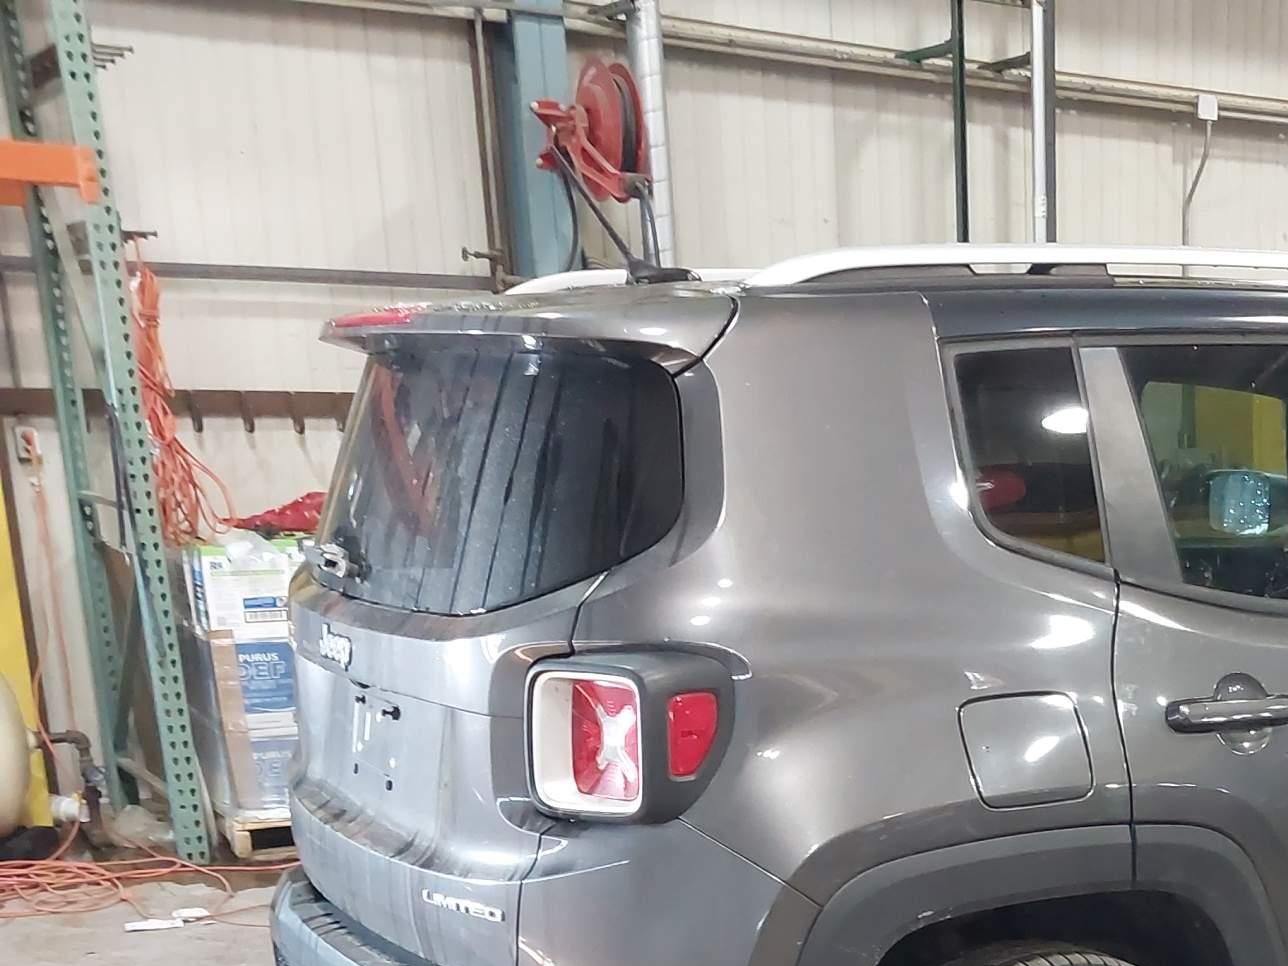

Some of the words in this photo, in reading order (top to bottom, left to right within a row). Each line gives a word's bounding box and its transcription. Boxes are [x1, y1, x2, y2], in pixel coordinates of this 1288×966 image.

[238, 652, 279, 663] PURUS
[320, 622, 352, 672] Jeep
[421, 887, 505, 923] LIMITED
